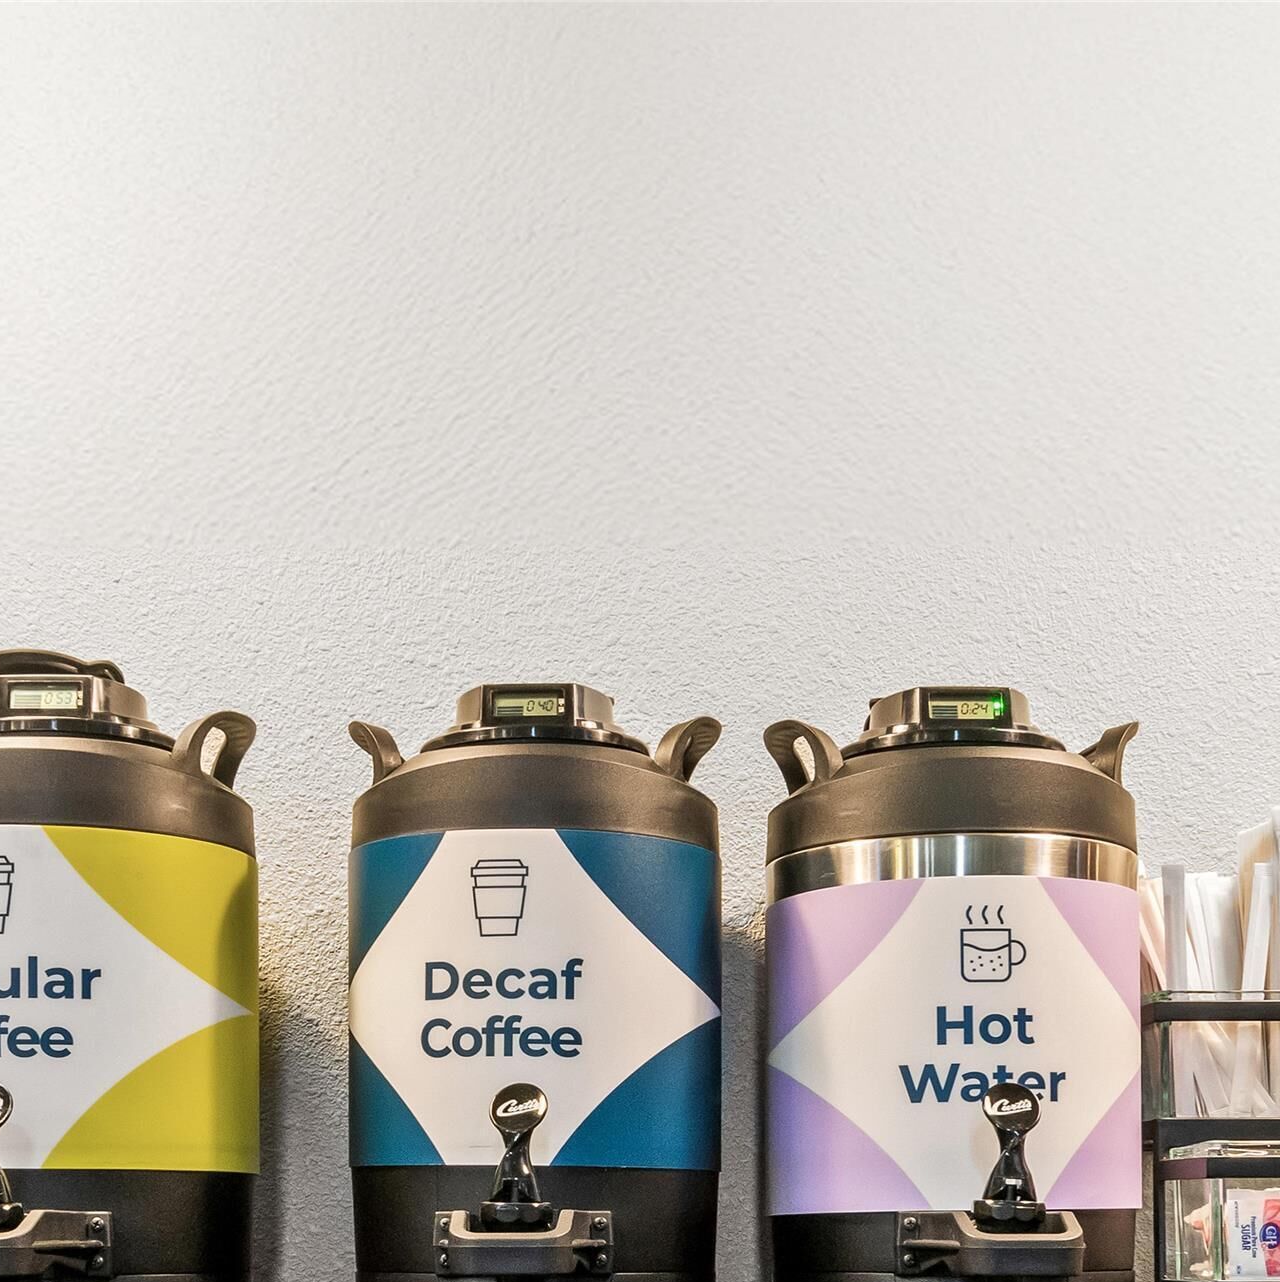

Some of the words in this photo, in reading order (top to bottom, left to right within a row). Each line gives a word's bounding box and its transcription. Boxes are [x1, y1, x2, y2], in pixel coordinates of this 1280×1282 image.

[424, 959, 584, 1001] Decaf
[421, 1015, 583, 1058] Coffee
[937, 1005, 1035, 1046] Hot
[1241, 1225, 1251, 1251] SUGAR
